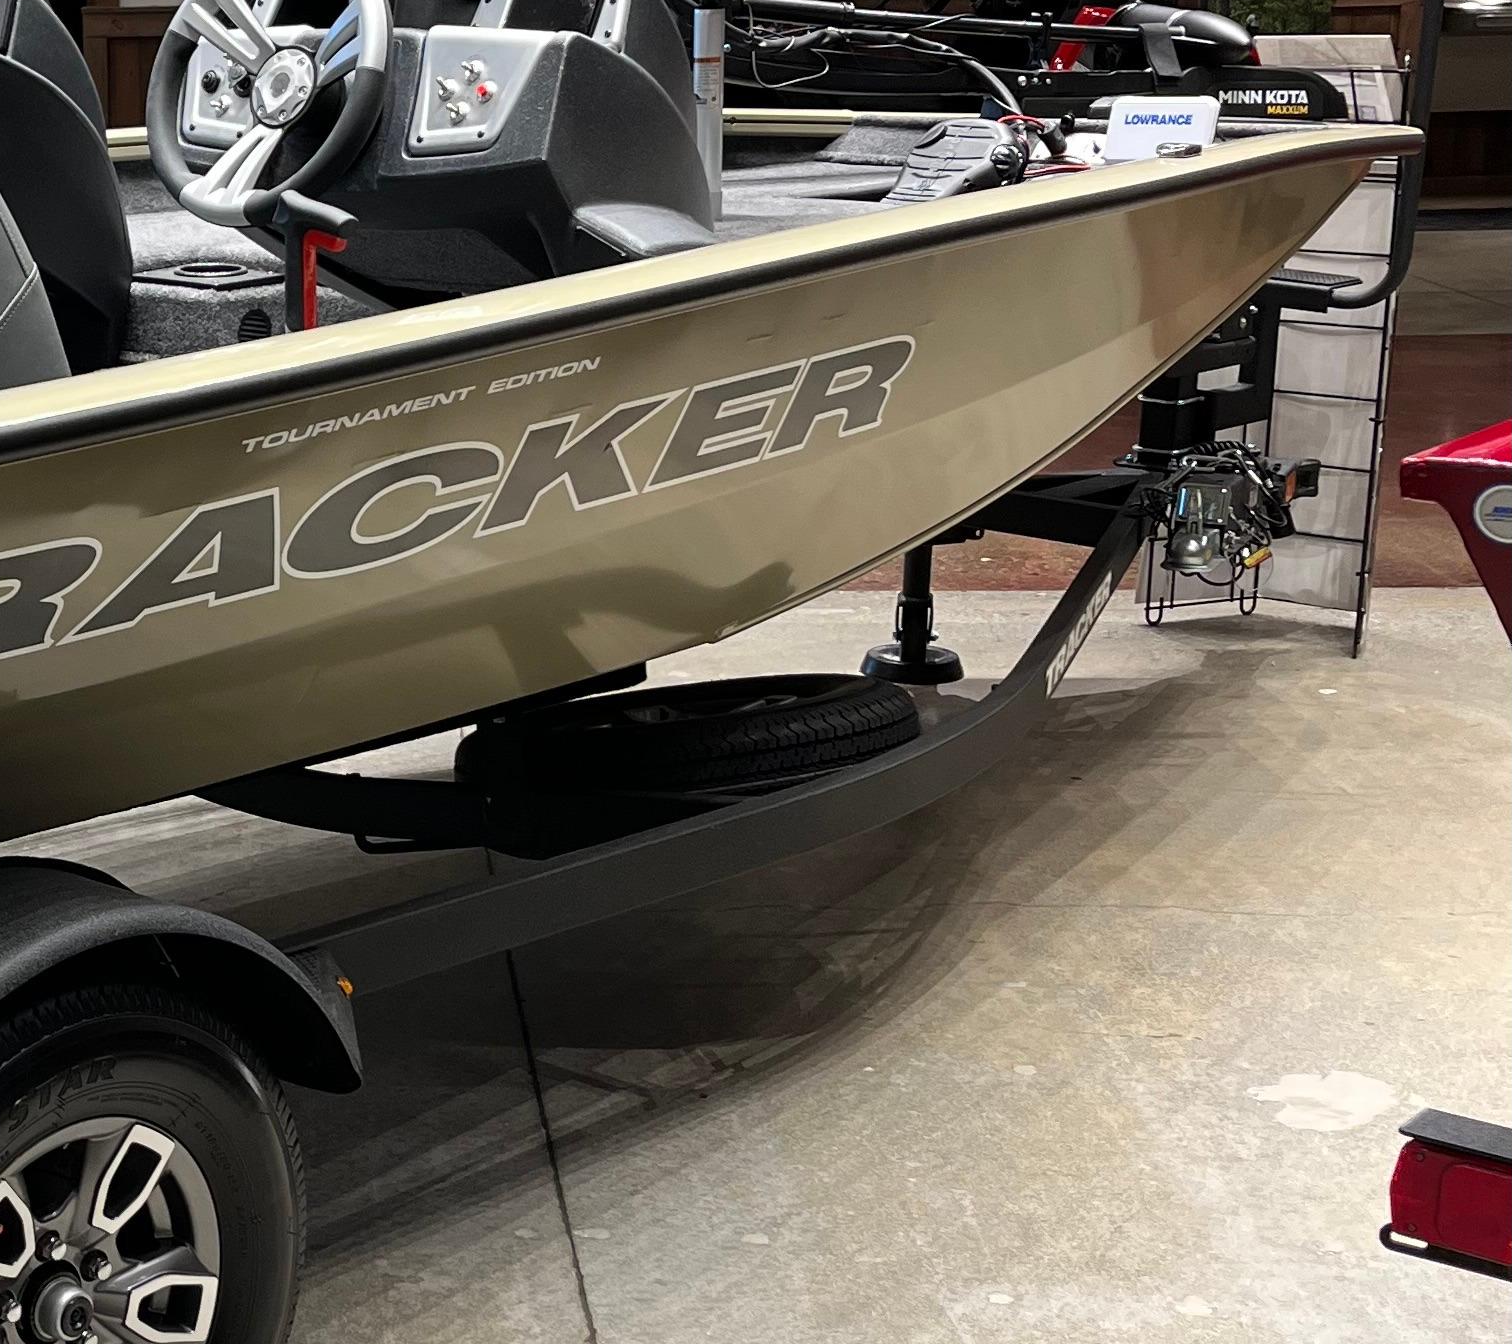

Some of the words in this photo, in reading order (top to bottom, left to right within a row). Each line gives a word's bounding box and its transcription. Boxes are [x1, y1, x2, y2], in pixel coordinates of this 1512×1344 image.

[1218, 90, 1263, 105] MINN
[1265, 90, 1309, 104] KOTA
[1266, 105, 1309, 115] MAXXUM
[1124, 114, 1193, 126] LOWRANCE
[241, 384, 477, 454] TOURNAMENT
[486, 356, 602, 396] EDITION
